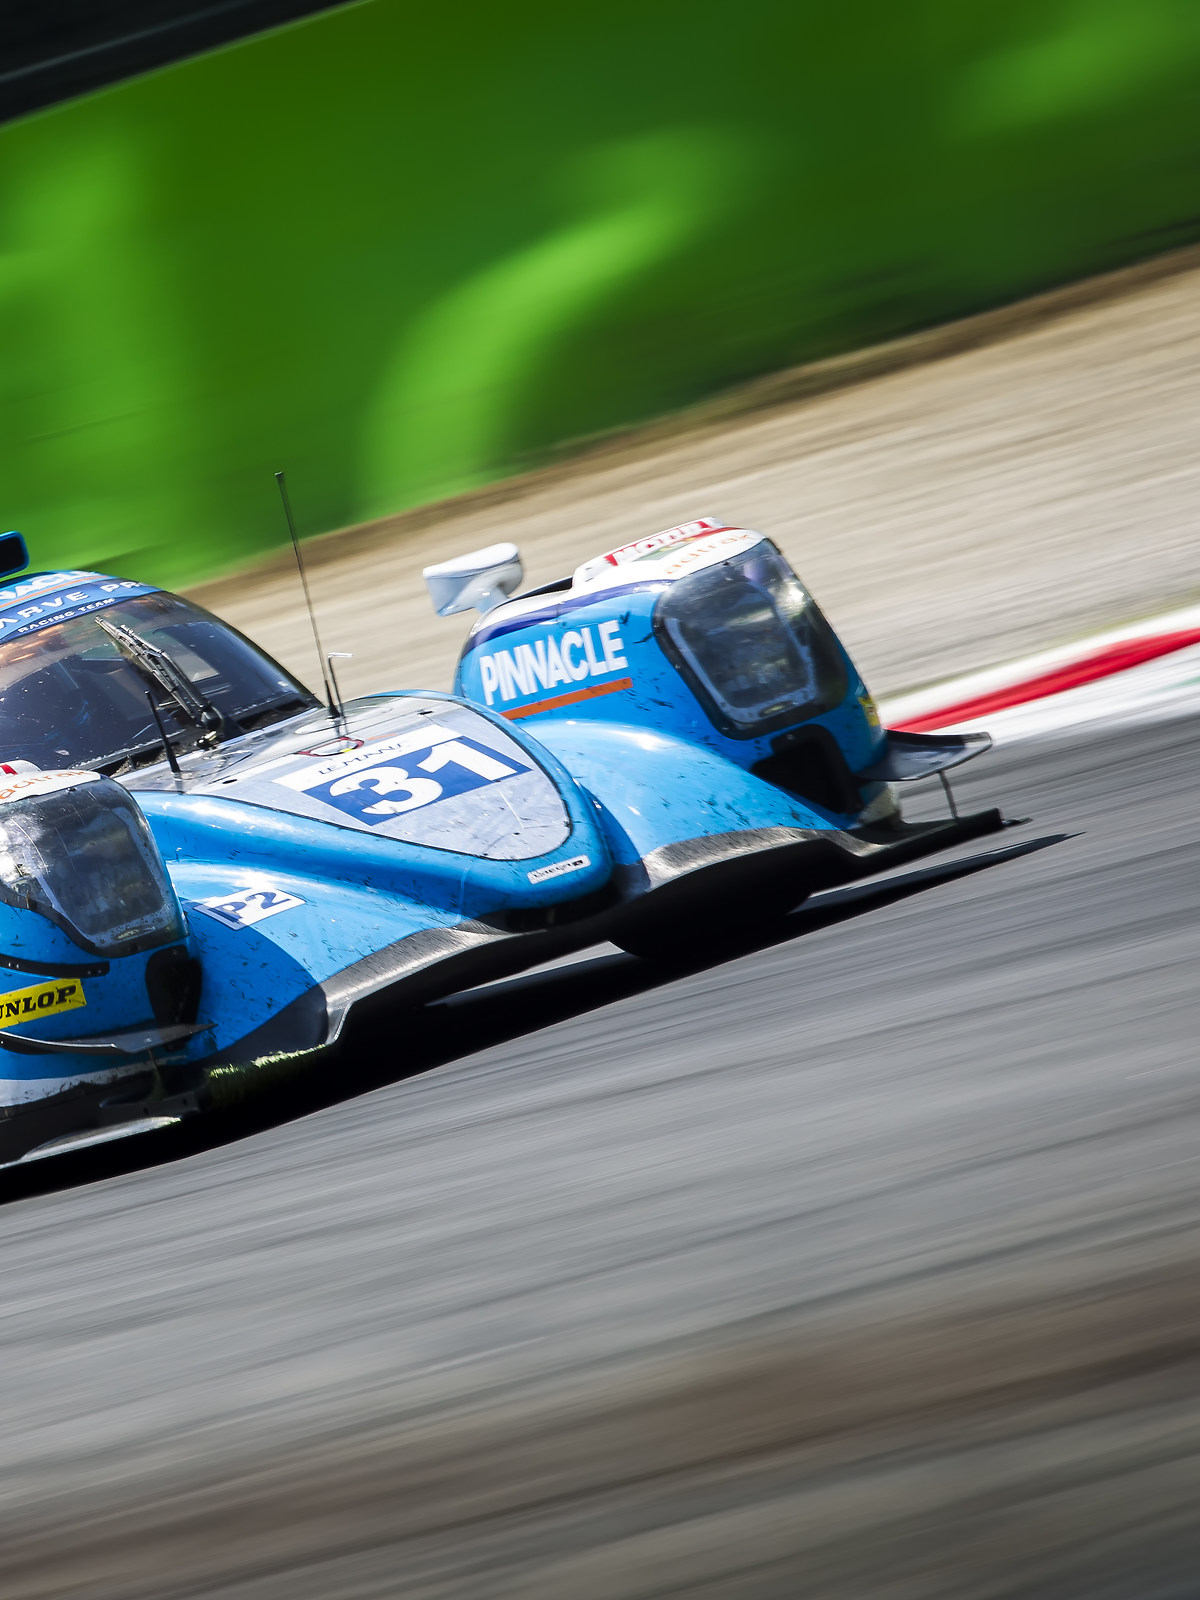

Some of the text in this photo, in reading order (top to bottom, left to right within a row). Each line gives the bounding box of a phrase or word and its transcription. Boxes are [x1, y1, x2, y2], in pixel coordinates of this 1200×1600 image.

[17, 597, 117, 633] RACING TEAM
[479, 619, 629, 706] PINNACLE
[329, 740, 519, 816] 31
[207, 891, 292, 923] P2
